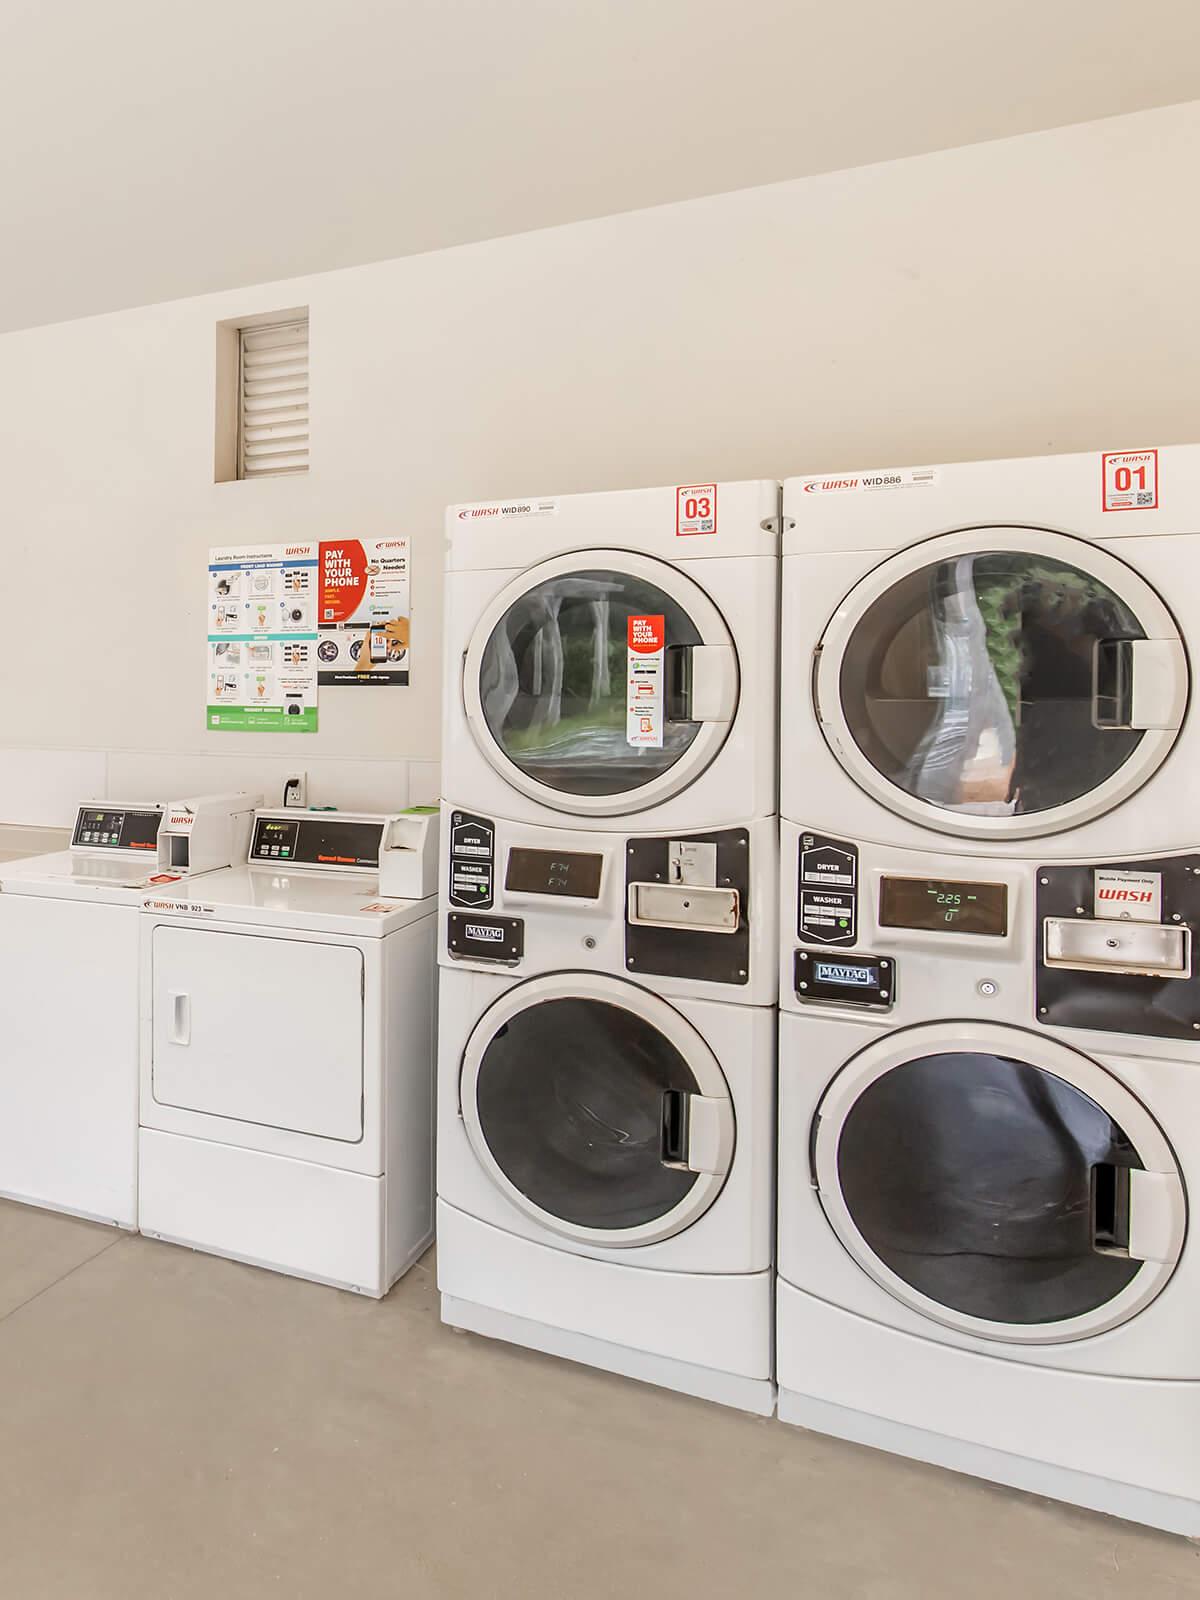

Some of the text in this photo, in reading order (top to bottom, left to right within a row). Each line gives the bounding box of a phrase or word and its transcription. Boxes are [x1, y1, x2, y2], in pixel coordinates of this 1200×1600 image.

[1115, 466, 1145, 491] 01
[822, 479, 857, 489] WASH
[472, 508, 499, 516] WASH
[686, 498, 710, 518] 03
[326, 550, 343, 559] PAY
[325, 560, 351, 568] WITH
[325, 568, 352, 577] YOUR
[325, 577, 359, 586] PHONE
[813, 896, 842, 904] WASHER
[1099, 889, 1152, 902] WASH
[154, 902, 174, 910] WASH
[468, 927, 502, 938] MAYTAG
[822, 967, 866, 978] MAYTAG
